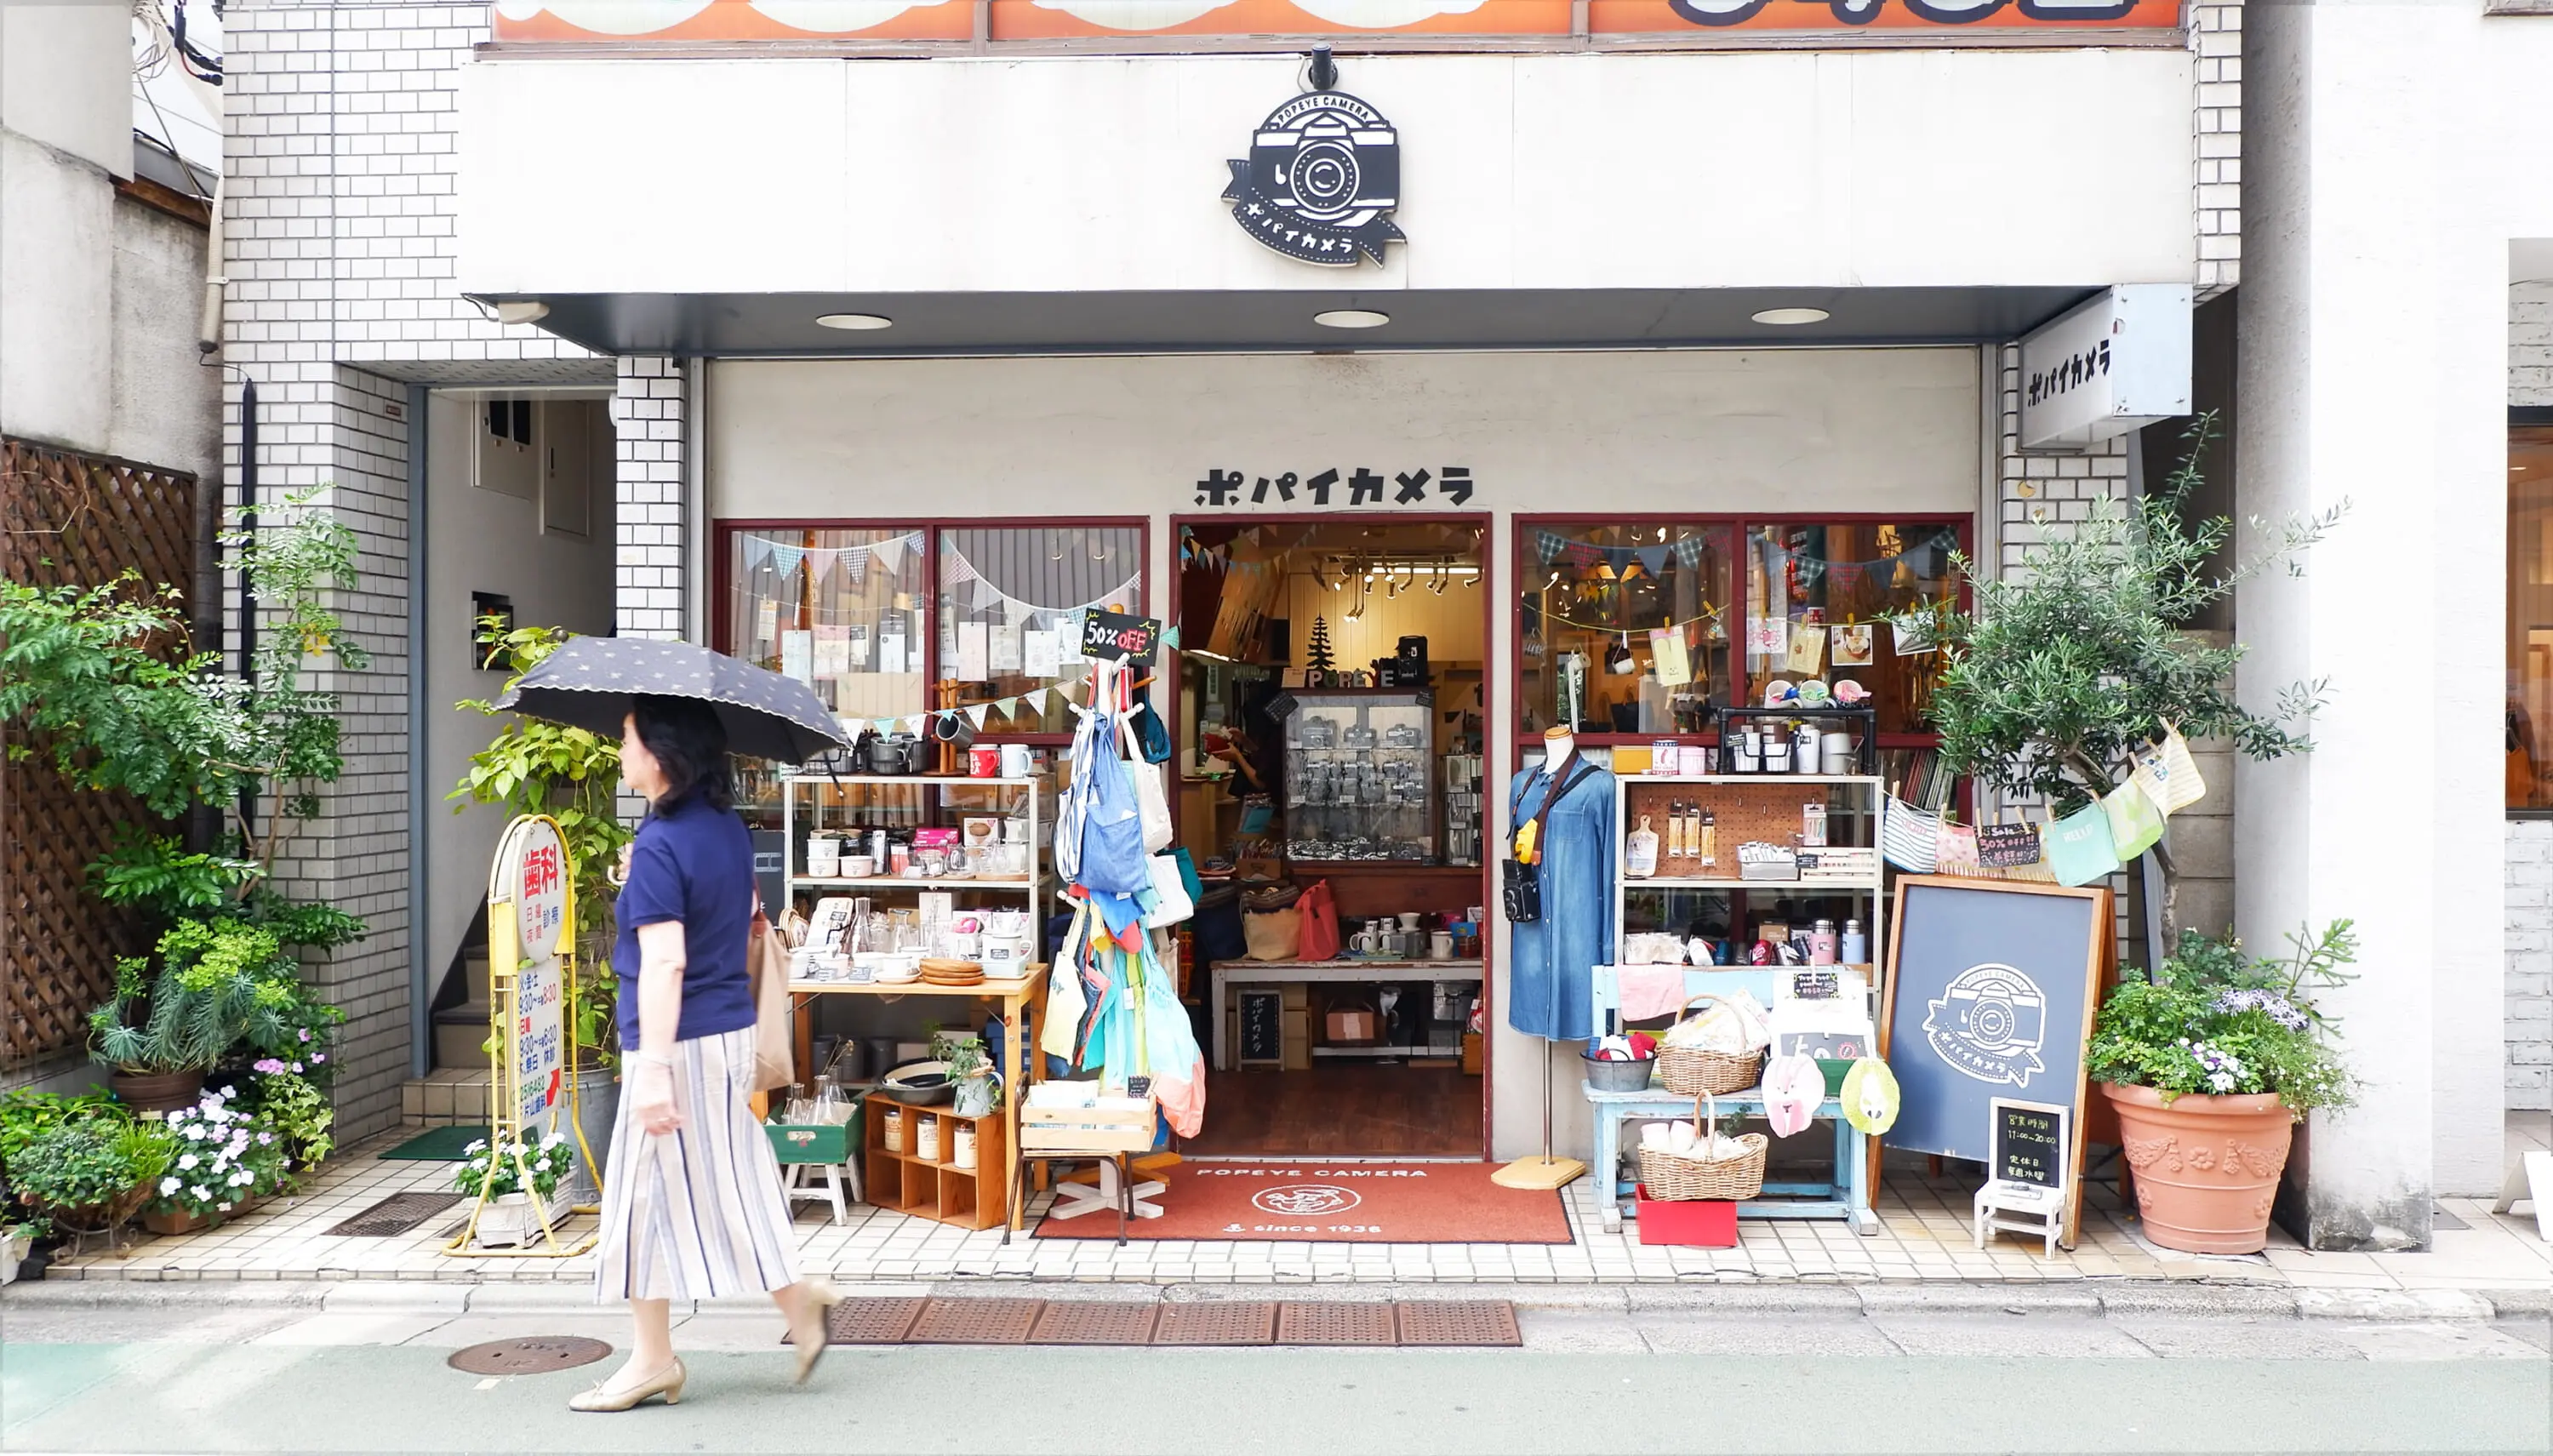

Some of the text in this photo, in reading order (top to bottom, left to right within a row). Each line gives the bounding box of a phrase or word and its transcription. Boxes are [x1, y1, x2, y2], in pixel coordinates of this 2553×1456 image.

[1278, 97, 1368, 123] POPEYE CAMERA
[1243, 203, 1352, 253] ポパイカメラ
[2028, 339, 2110, 407] ポパイカメラ
[1194, 467, 1473, 505] ポパイカメラ
[1086, 620, 1119, 647] 50%
[1309, 668, 1395, 688] POPEYE
[1991, 826, 2015, 837] Sale
[523, 843, 559, 900] 歯科
[1939, 1031, 2007, 1073] ポパイカメラ
[1254, 1224, 1318, 1232] since
